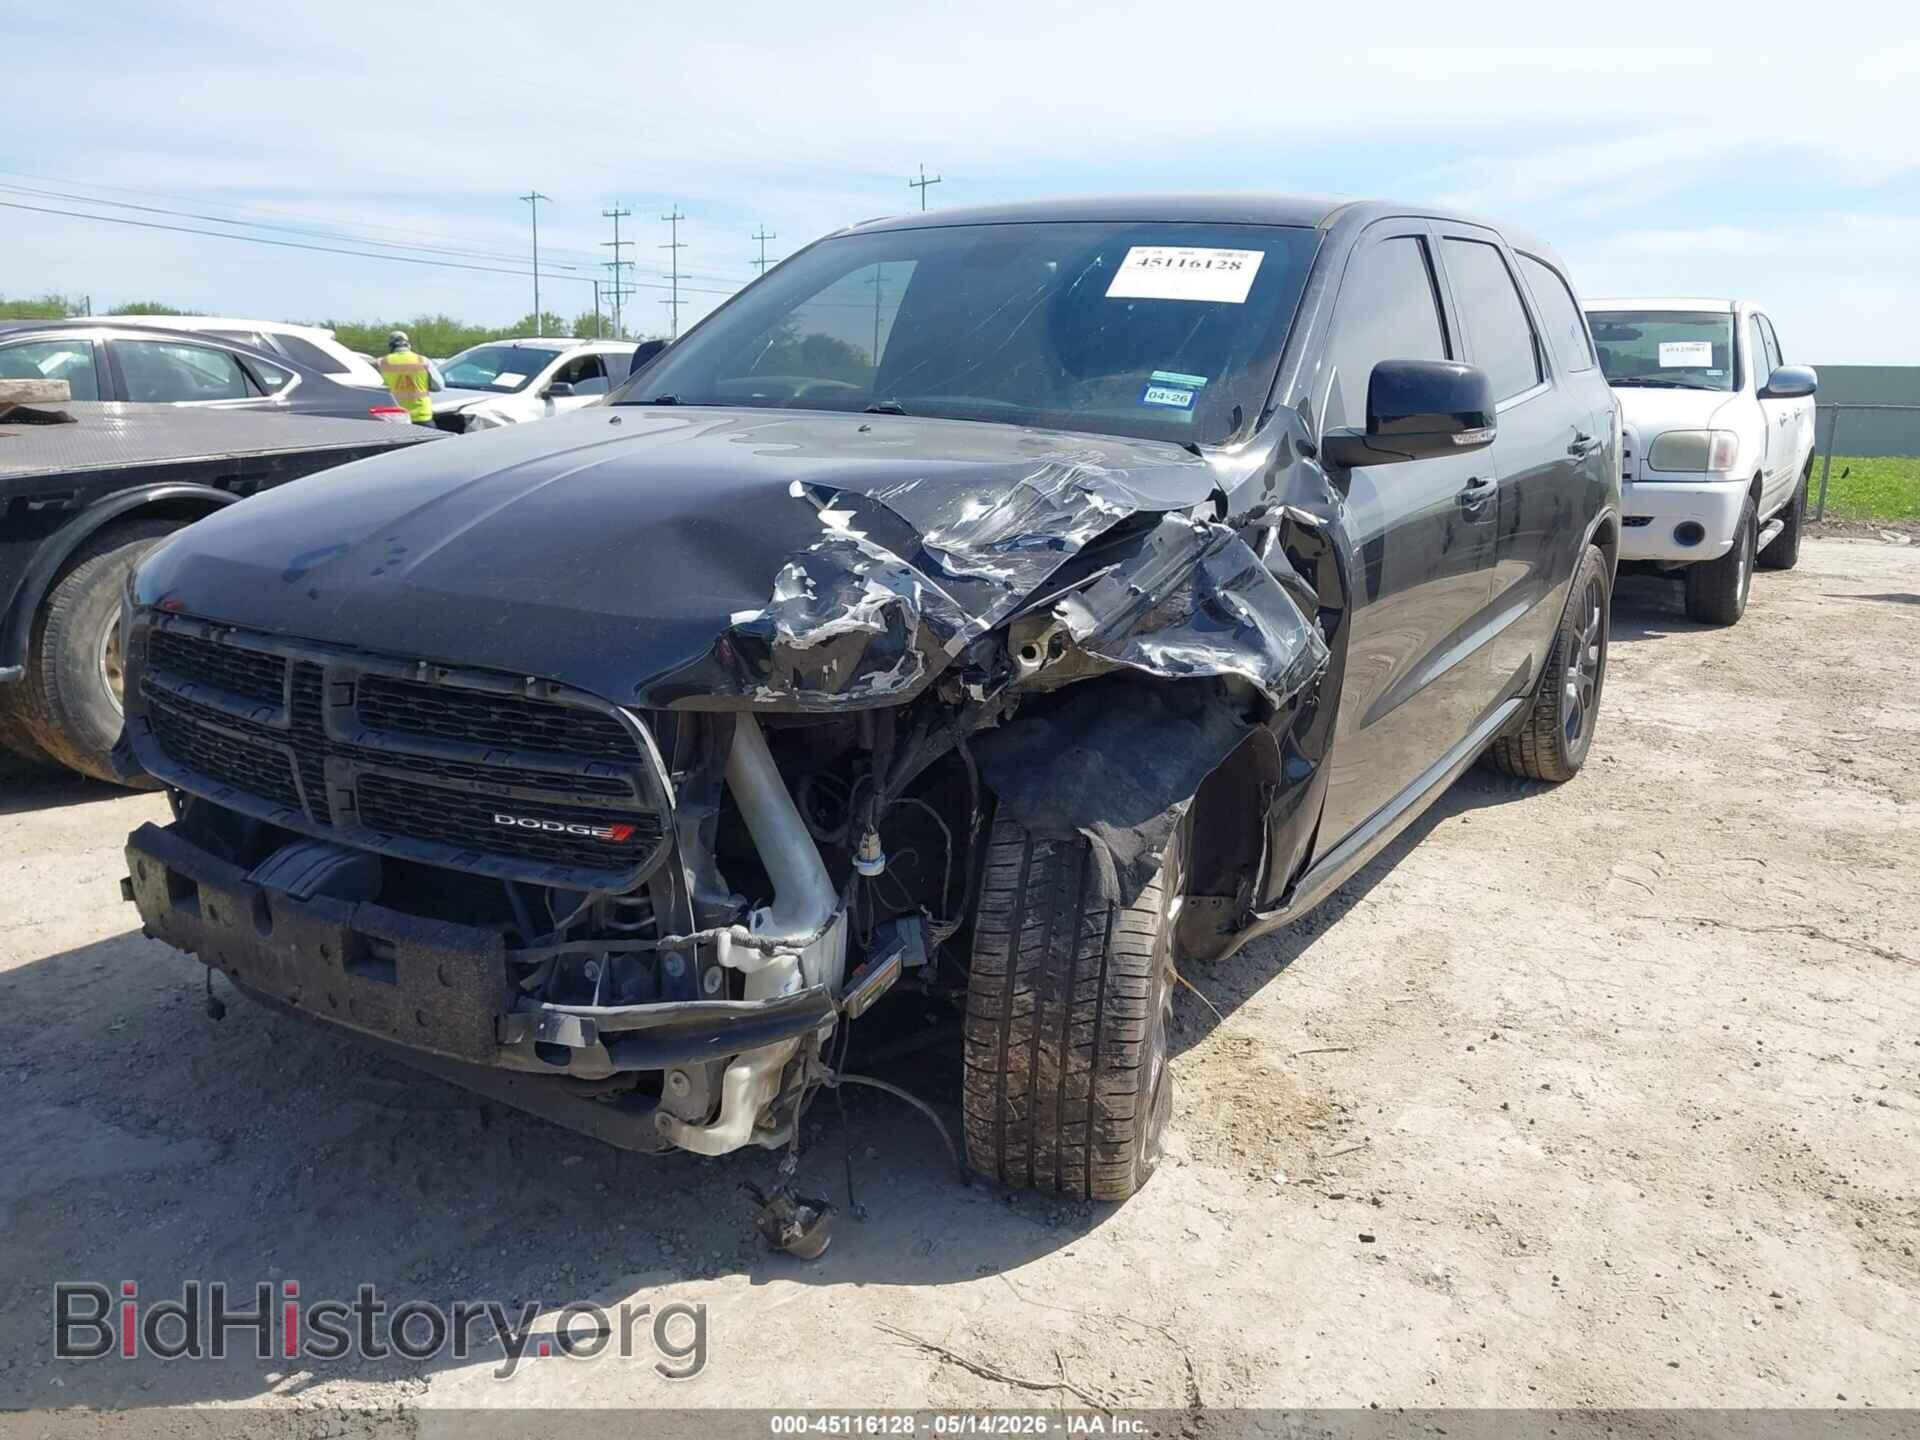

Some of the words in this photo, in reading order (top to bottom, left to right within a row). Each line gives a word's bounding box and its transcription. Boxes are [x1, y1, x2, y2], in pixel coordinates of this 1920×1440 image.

[1137, 256, 1242, 271] 45116128
[1148, 391, 1189, 404] 04-26
[494, 814, 614, 840] DODGE
